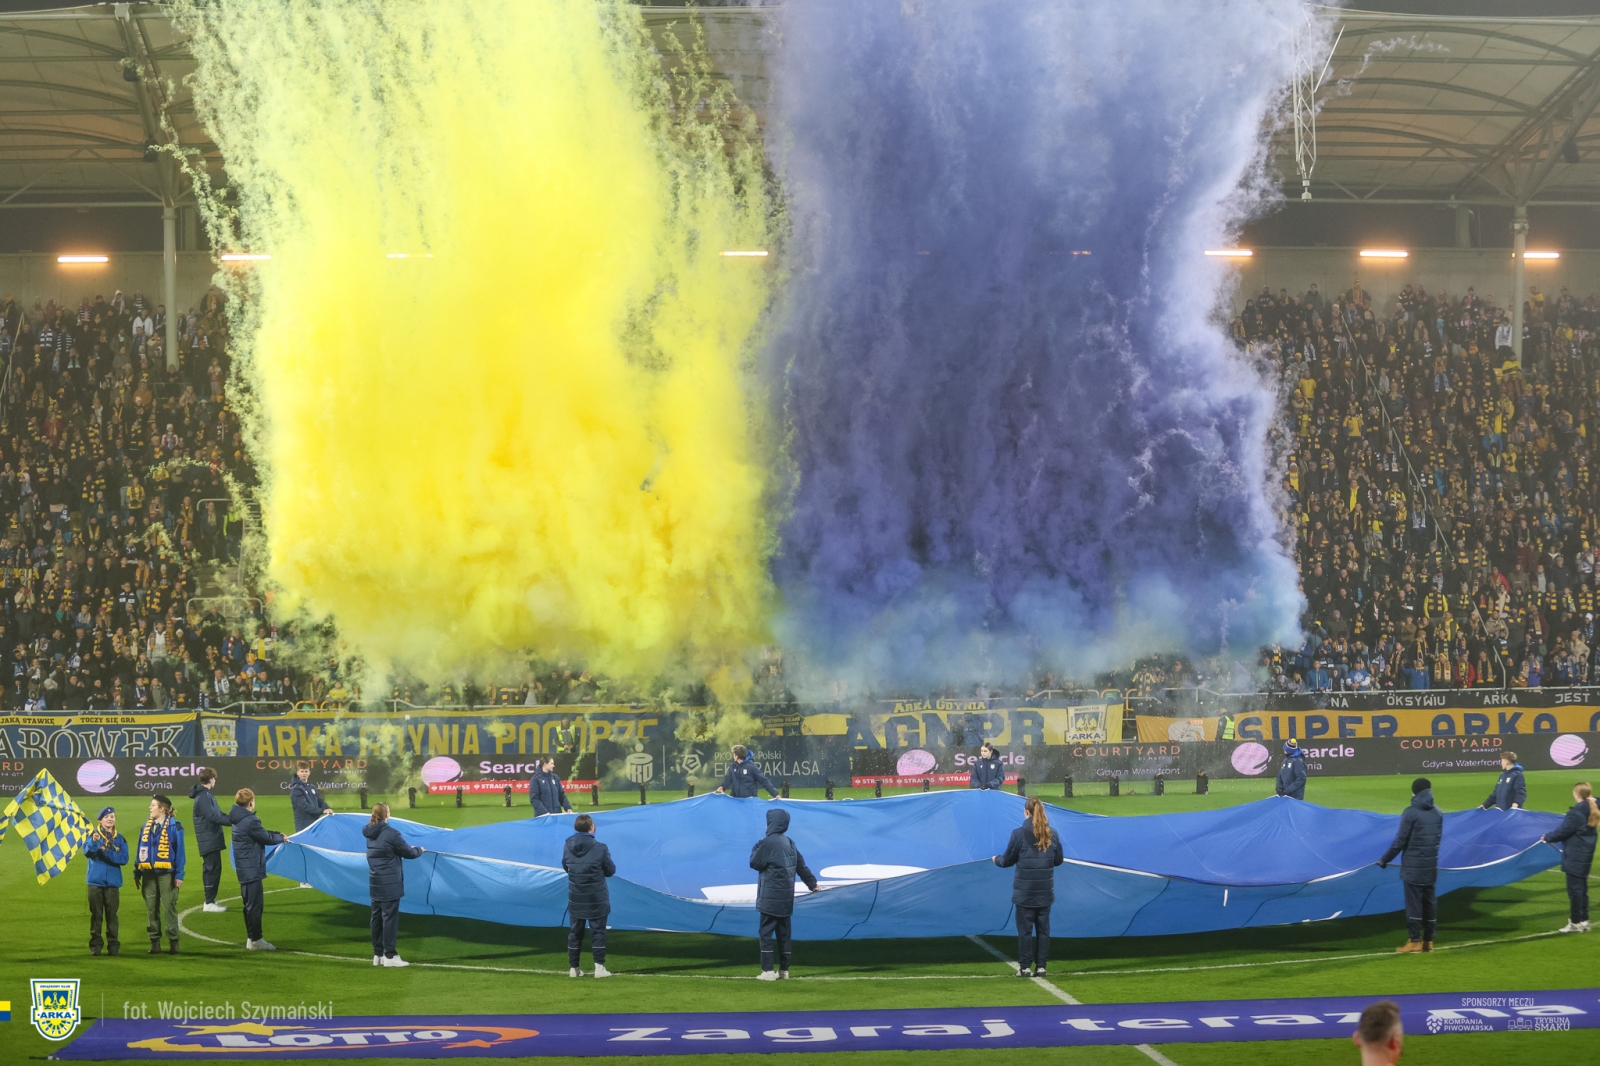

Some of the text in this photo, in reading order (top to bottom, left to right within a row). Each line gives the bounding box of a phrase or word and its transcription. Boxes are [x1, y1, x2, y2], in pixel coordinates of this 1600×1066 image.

[893, 698, 986, 713] ARKA GDYNIA
[1331, 697, 1349, 708] NA
[1483, 694, 1518, 705] ARKA
[1555, 692, 1590, 704] JEST
[1238, 712, 1558, 741] SUPER ARKA
[257, 725, 342, 757] ARKA
[1400, 738, 1503, 749] COURTYARD
[757, 751, 781, 760] Polski
[1073, 745, 1181, 757] COURTYARD
[1302, 744, 1355, 758] earcle
[255, 760, 368, 770] COUTYARD
[954, 752, 1026, 766] Secle
[1422, 758, 1502, 769] Gdynia Waterfront
[479, 760, 541, 774] Searcl
[714, 761, 820, 777] EKRAKLASA
[1096, 767, 1129, 777] Gdynia
[135, 781, 173, 791] Gdynia
[606, 1019, 1016, 1043] zagraj
[215, 1030, 459, 1047] LOTTO
